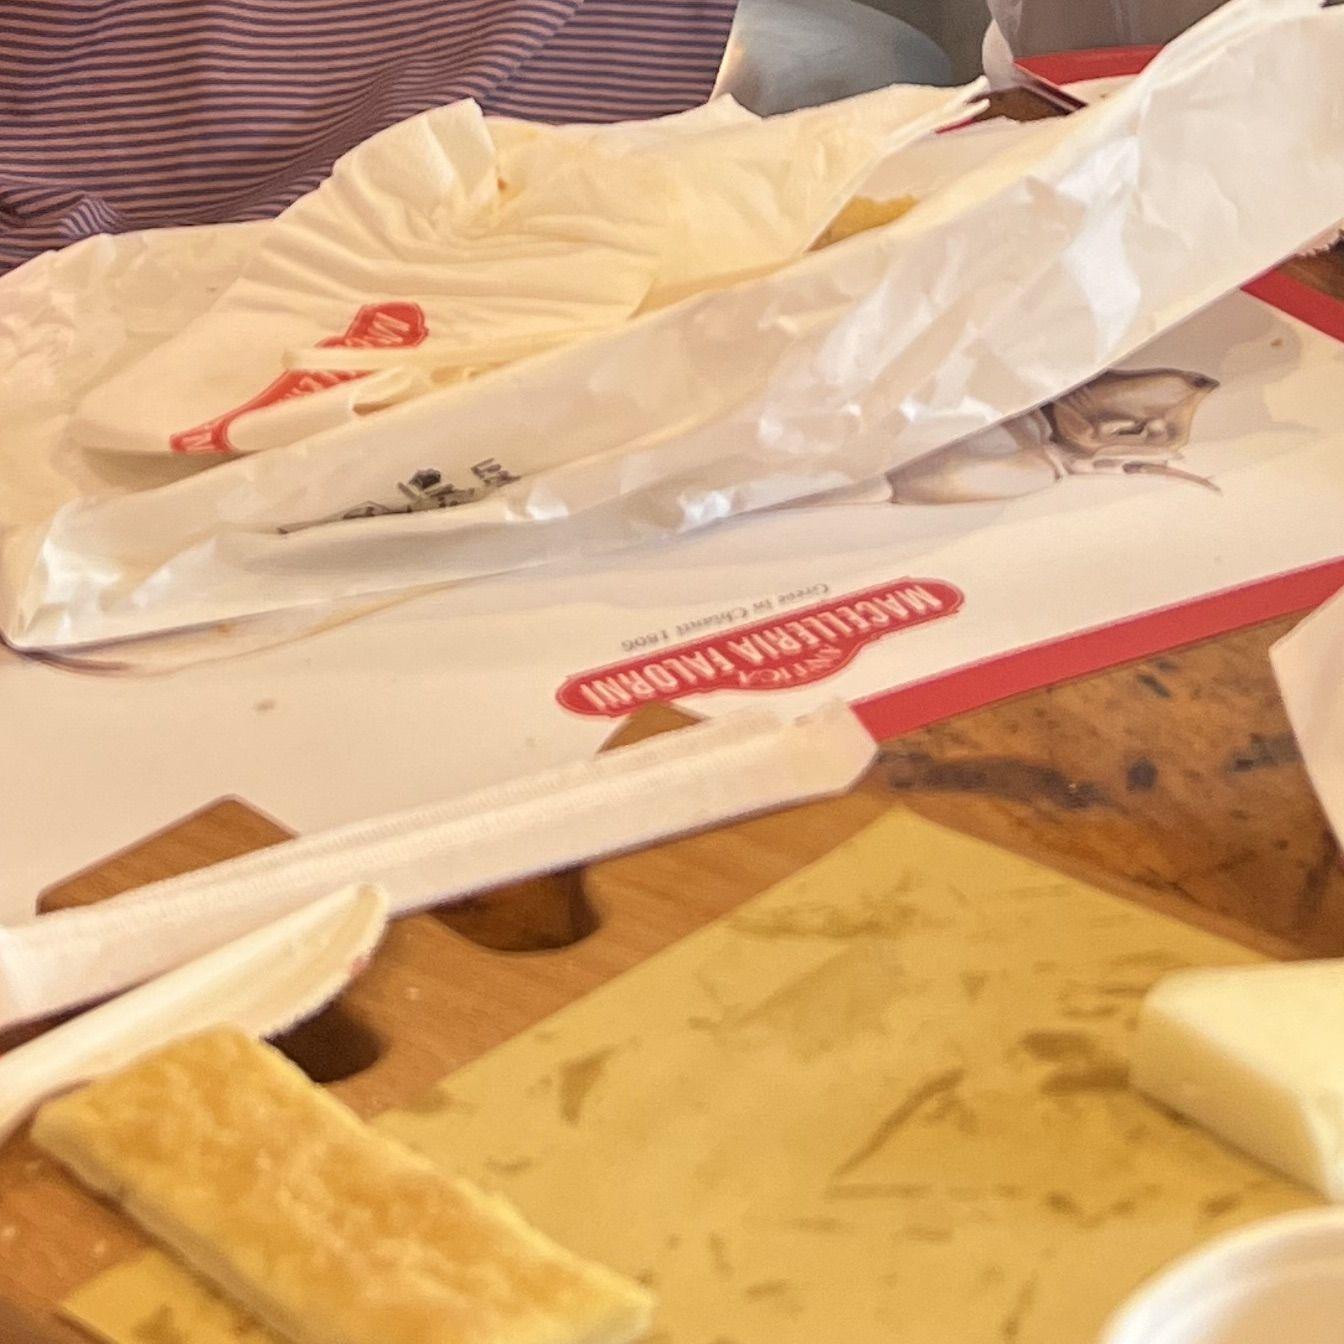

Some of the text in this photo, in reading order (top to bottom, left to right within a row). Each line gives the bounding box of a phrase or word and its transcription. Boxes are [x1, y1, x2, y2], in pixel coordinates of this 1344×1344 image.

[579, 585, 943, 711] MACELLERIA FALORNI
[737, 643, 843, 687] ANTICA
